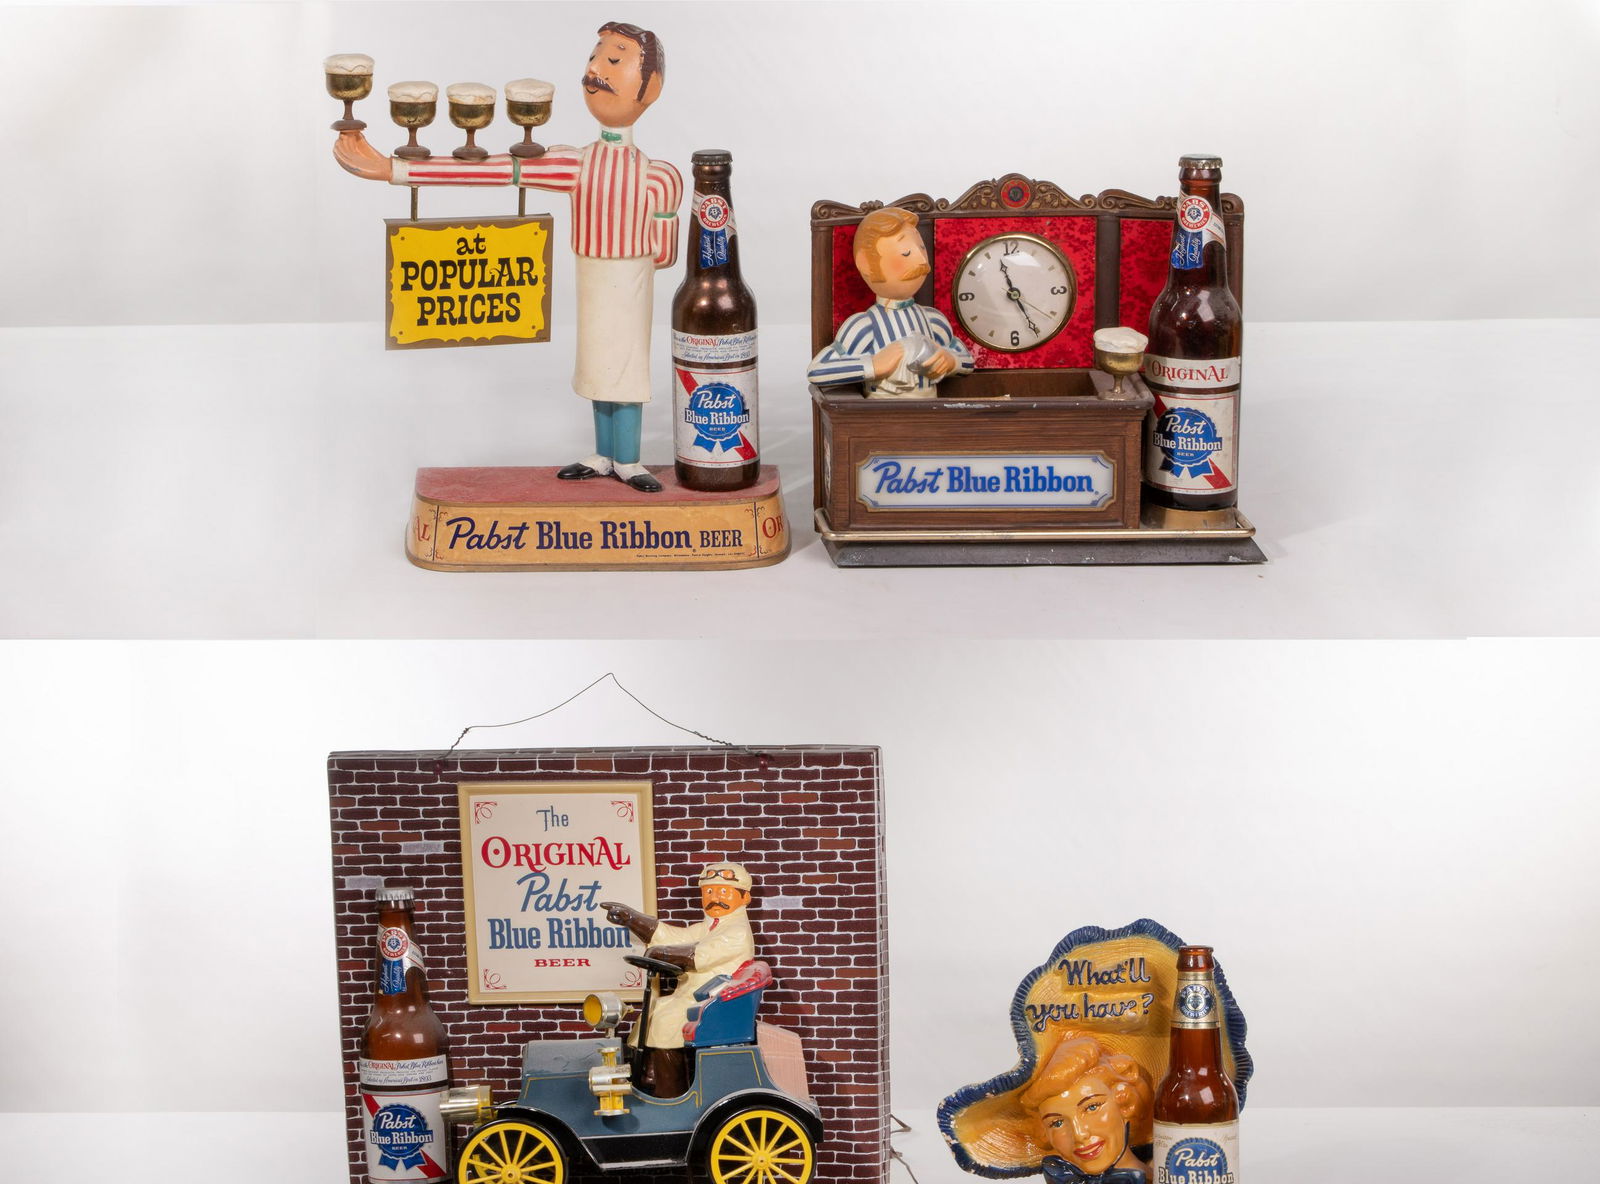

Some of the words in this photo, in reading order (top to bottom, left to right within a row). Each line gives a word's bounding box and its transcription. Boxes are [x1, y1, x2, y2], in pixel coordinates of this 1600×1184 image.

[701, 198, 727, 212] PABST
[1181, 199, 1209, 212] PABST
[456, 233, 487, 256] at
[1003, 240, 1019, 256] 12
[400, 257, 538, 291] POPULAR
[1051, 285, 1067, 295] 3
[416, 292, 521, 326] PRICES
[1152, 360, 1229, 382] ORIGINAL
[697, 390, 736, 409] Pabst
[686, 409, 708, 424] Blue
[710, 411, 749, 425] Ribbon
[1165, 414, 1206, 434] Pabst
[1154, 433, 1176, 449] Blue
[1178, 436, 1222, 451] Ribbon
[873, 461, 943, 493] Pabst
[946, 466, 1000, 493] Blue
[1004, 466, 1094, 493] Ribbon
[446, 517, 530, 550] Pabst
[536, 521, 593, 550] Blue
[600, 520, 692, 549] Ribbon
[699, 529, 743, 548] BEER
[536, 805, 569, 832] The
[481, 836, 631, 873] ORIGINAL
[516, 872, 601, 912] Pabst
[488, 919, 541, 949] Blue
[546, 918, 632, 949] Ribbon
[534, 958, 591, 968] BEER
[1058, 957, 1151, 985] What'll
[1025, 1003, 1080, 1032] you
[379, 1112, 416, 1129] Pabst
[370, 1131, 391, 1144] Blue
[391, 1131, 432, 1144] Ribbon
[1175, 1148, 1220, 1167] Pabst
